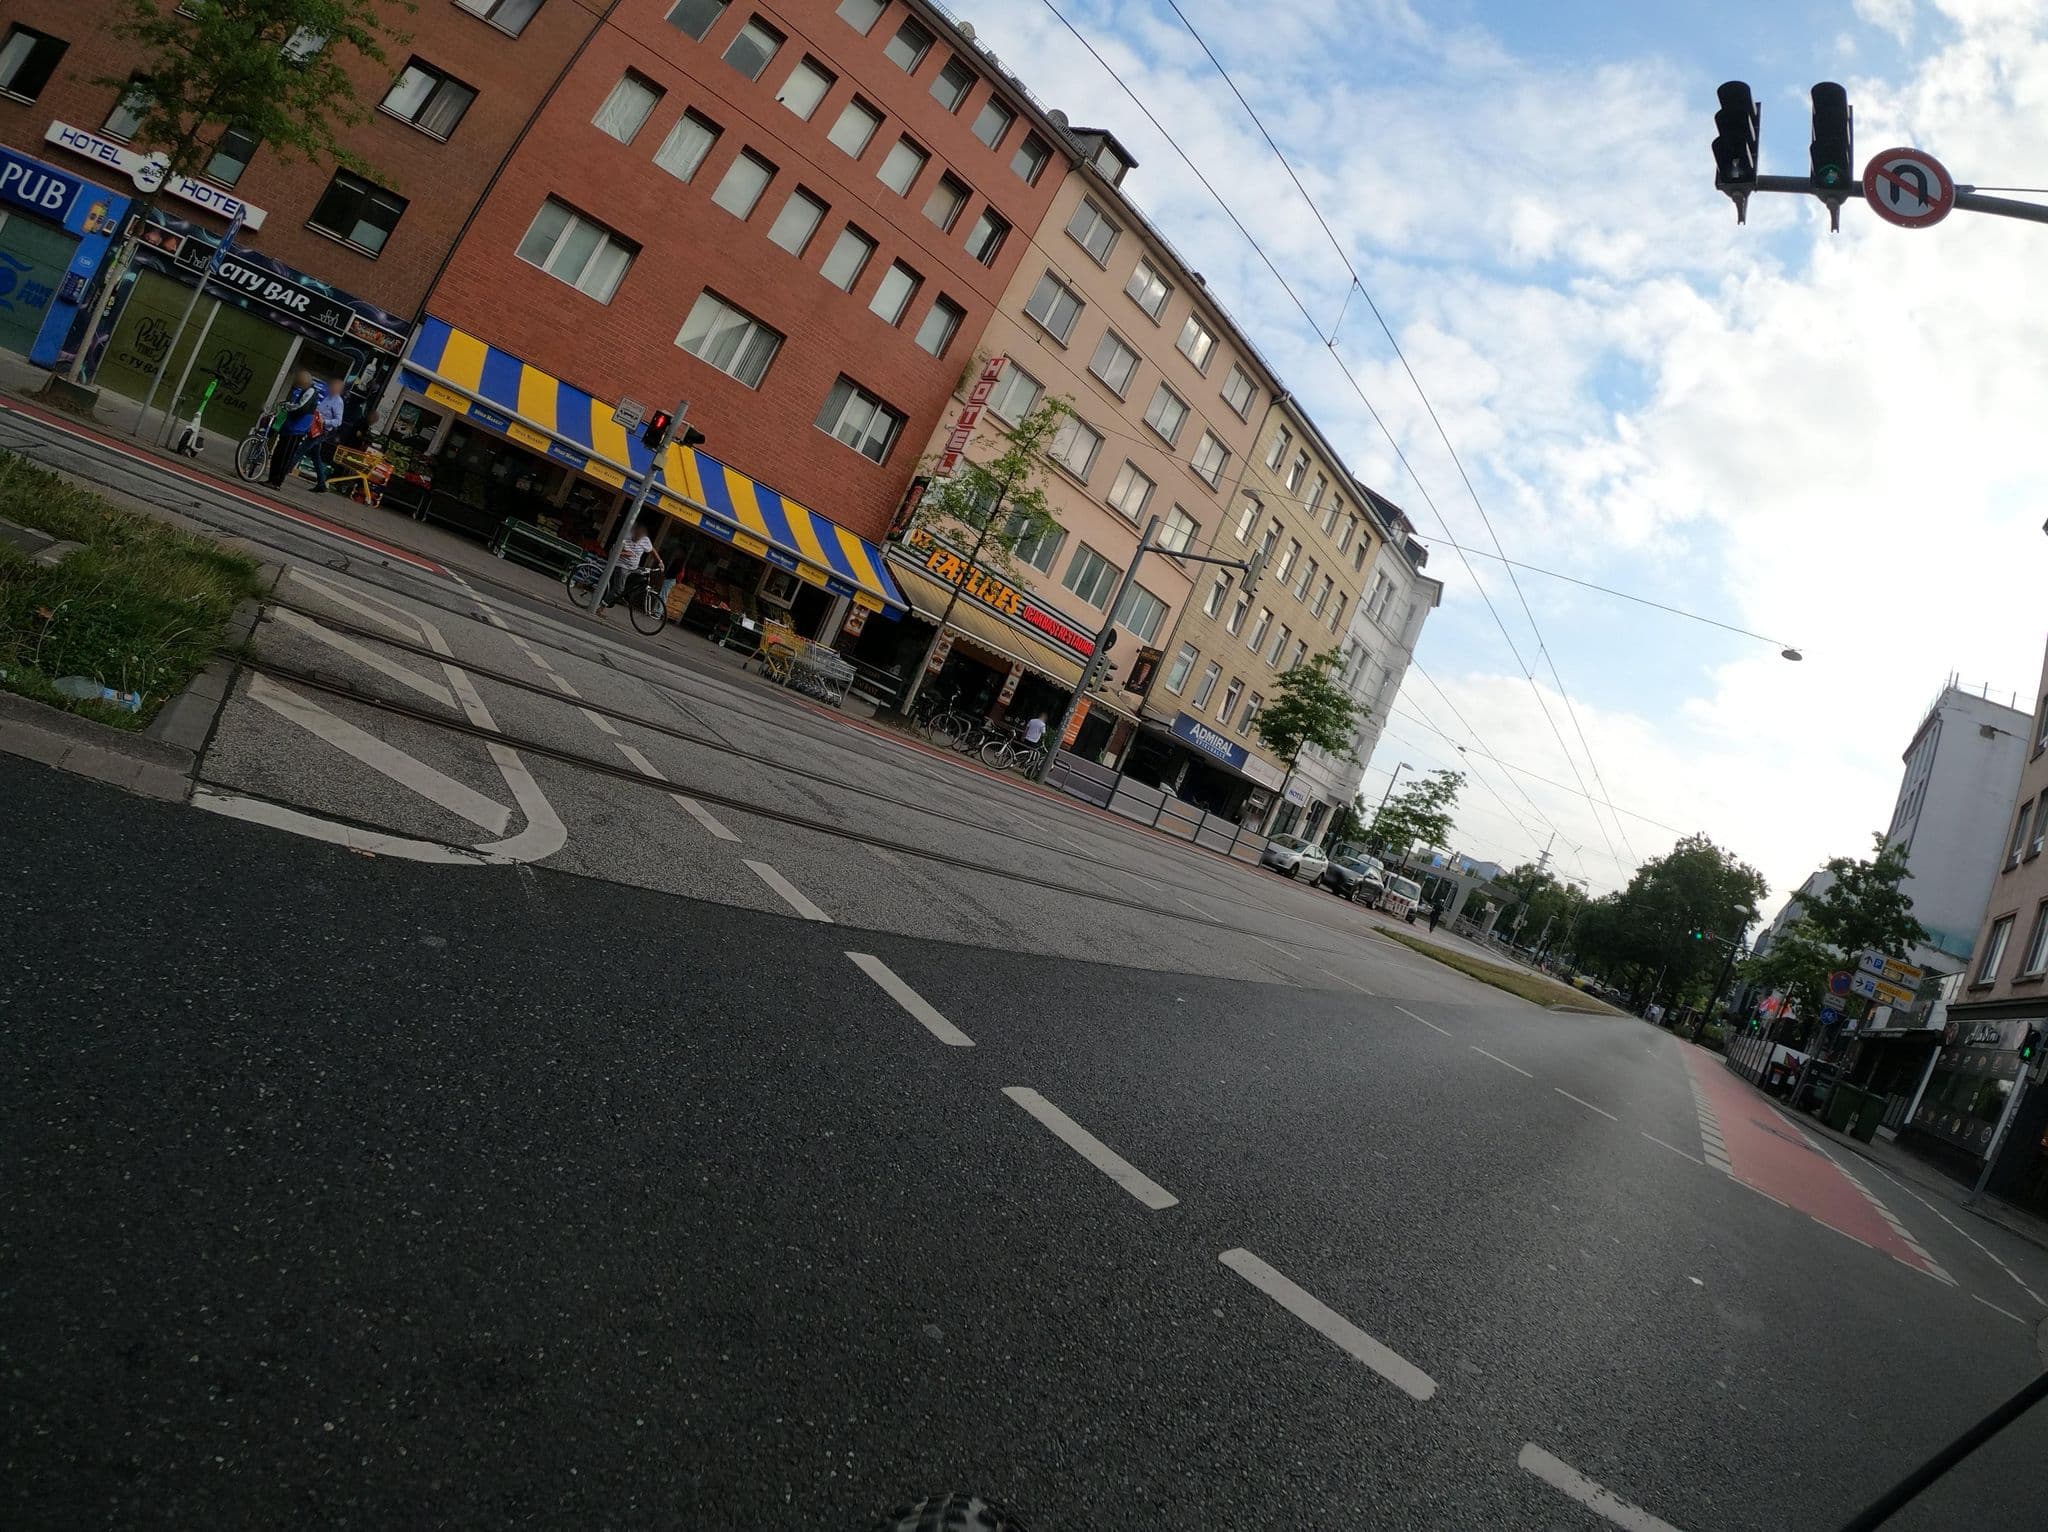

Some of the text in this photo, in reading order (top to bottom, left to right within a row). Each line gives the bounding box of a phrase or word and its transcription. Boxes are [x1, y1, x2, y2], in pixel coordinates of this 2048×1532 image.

[59, 128, 122, 166] HOTEL
[0, 161, 67, 210] PUB
[179, 179, 240, 214] HOTE
[218, 261, 311, 313] CITY BAR
[936, 358, 1004, 473] HOTEL
